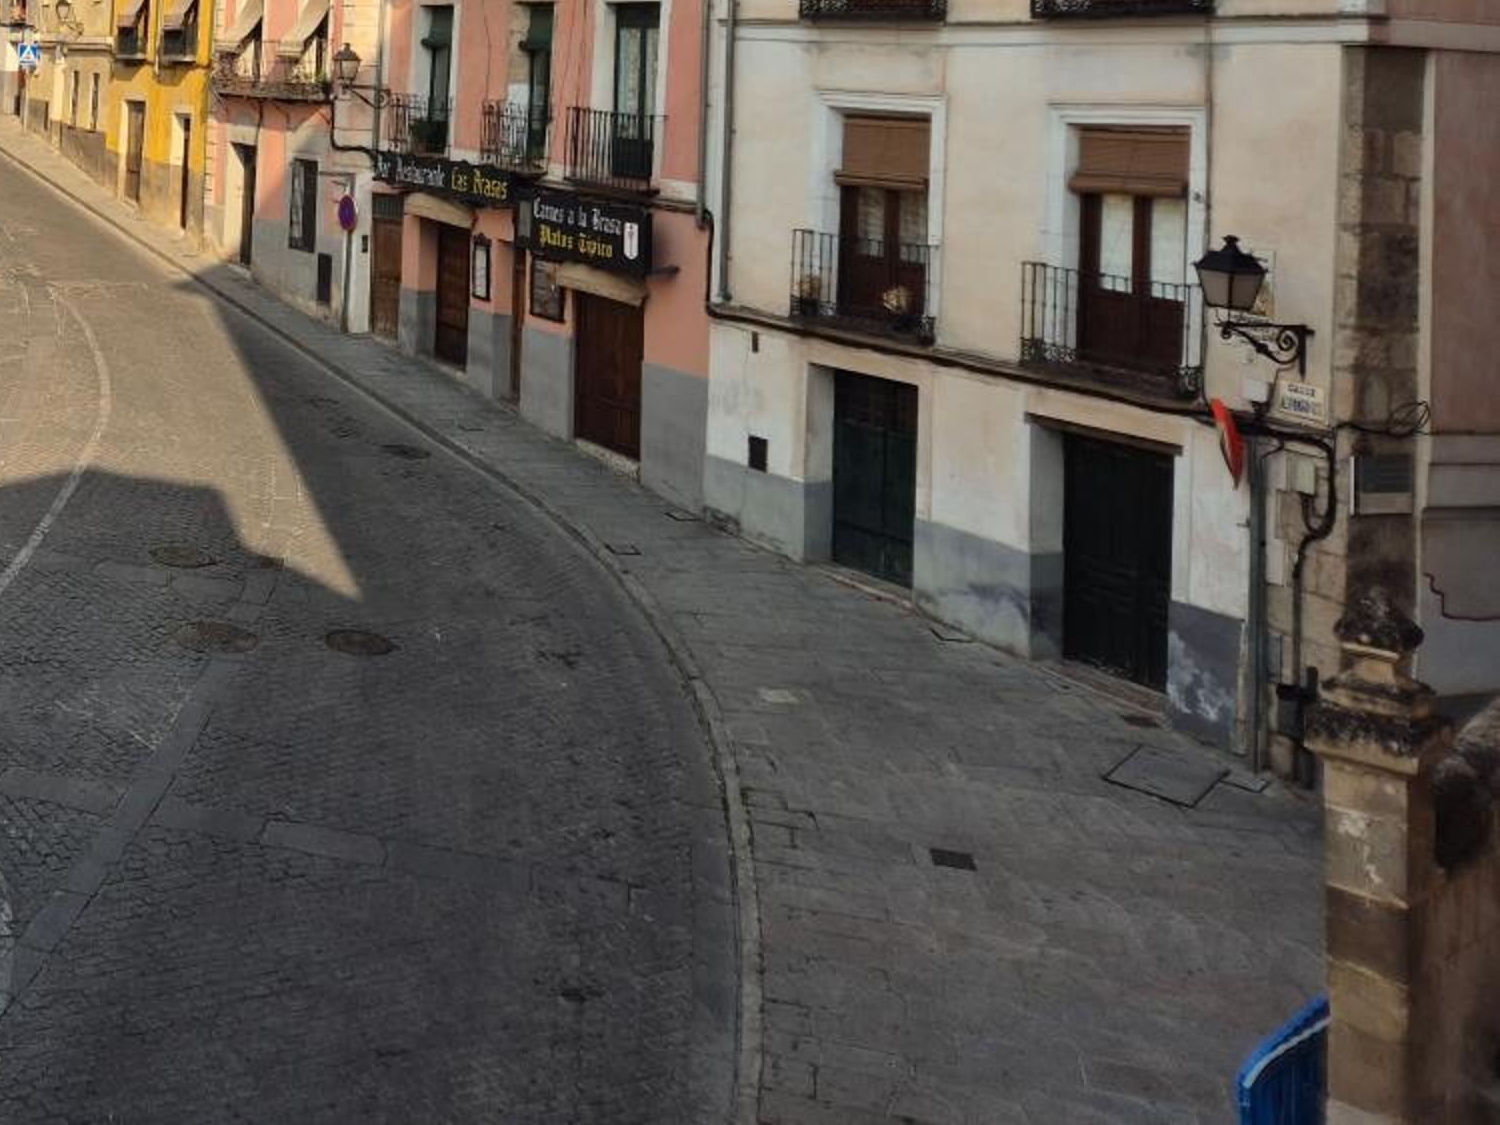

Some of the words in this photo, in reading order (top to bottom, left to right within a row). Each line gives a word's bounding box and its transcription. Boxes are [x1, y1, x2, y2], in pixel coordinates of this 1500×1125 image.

[533, 196, 565, 224] Carnes
[567, 209, 575, 225] a
[578, 206, 588, 228] la
[592, 207, 622, 236] Brasa
[540, 223, 573, 250] Platos
